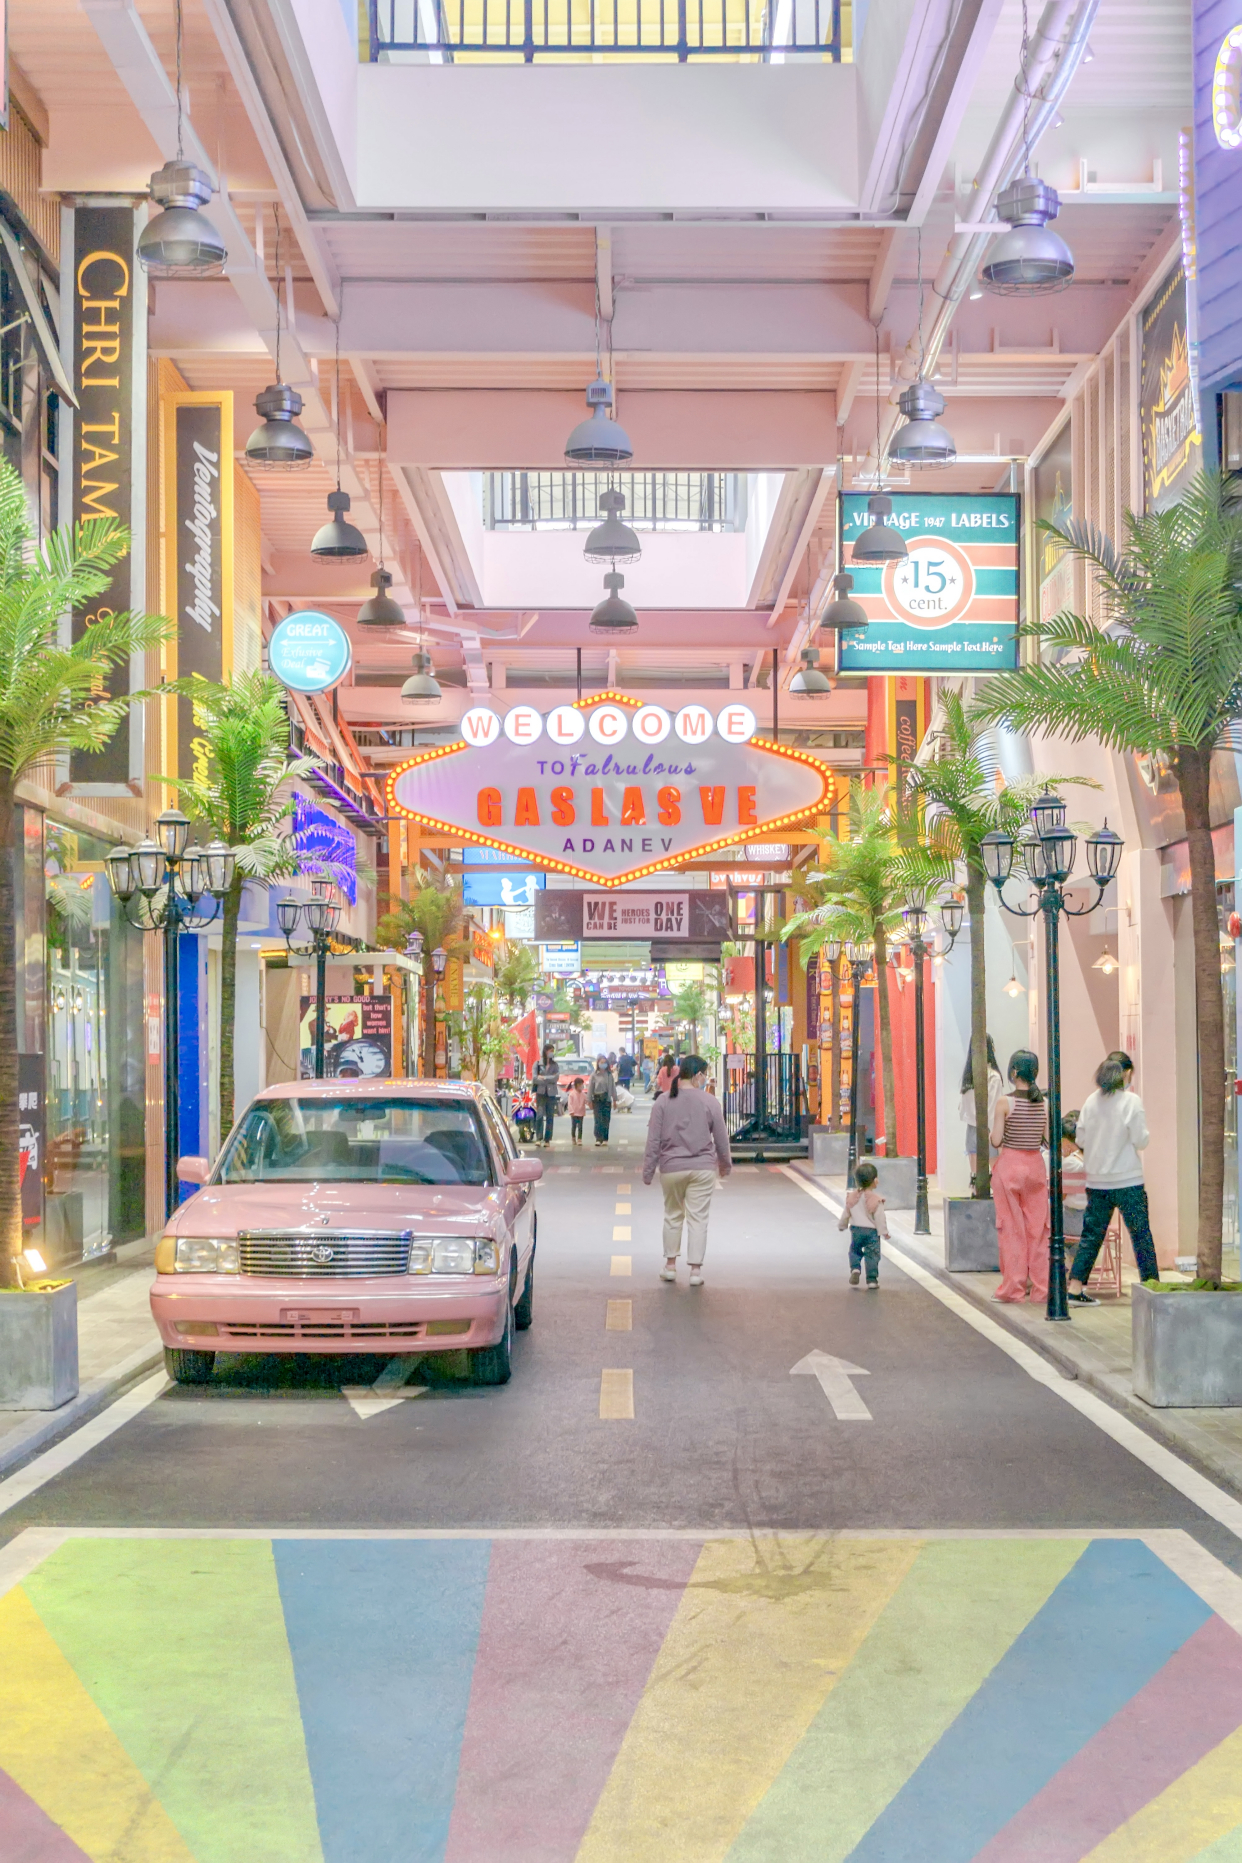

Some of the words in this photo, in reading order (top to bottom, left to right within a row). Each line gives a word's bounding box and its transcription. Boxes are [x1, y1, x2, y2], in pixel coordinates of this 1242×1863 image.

[77, 251, 129, 389] CHRI
[924, 517, 945, 528] 1947
[951, 513, 1010, 528] LABELS
[910, 560, 947, 594] 15
[909, 597, 948, 610] cent.
[286, 624, 330, 637] GREAT
[853, 641, 886, 652] Sample
[887, 641, 905, 651] Text
[906, 641, 928, 651] Here
[929, 641, 961, 653] Sample
[963, 642, 980, 652] Text
[982, 642, 1004, 652] Here
[281, 658, 307, 668] Deal
[467, 712, 745, 738] WELCOME
[898, 716, 916, 763] coffee
[537, 761, 565, 775] TO
[562, 838, 673, 853] ADANEV
[748, 844, 786, 855] WHISKEY
[586, 901, 618, 921] WE
[621, 908, 650, 917] HEROES
[654, 901, 683, 916] ONE
[586, 921, 604, 930] CAN
[607, 921, 618, 930] BE
[654, 917, 683, 931] DAY
